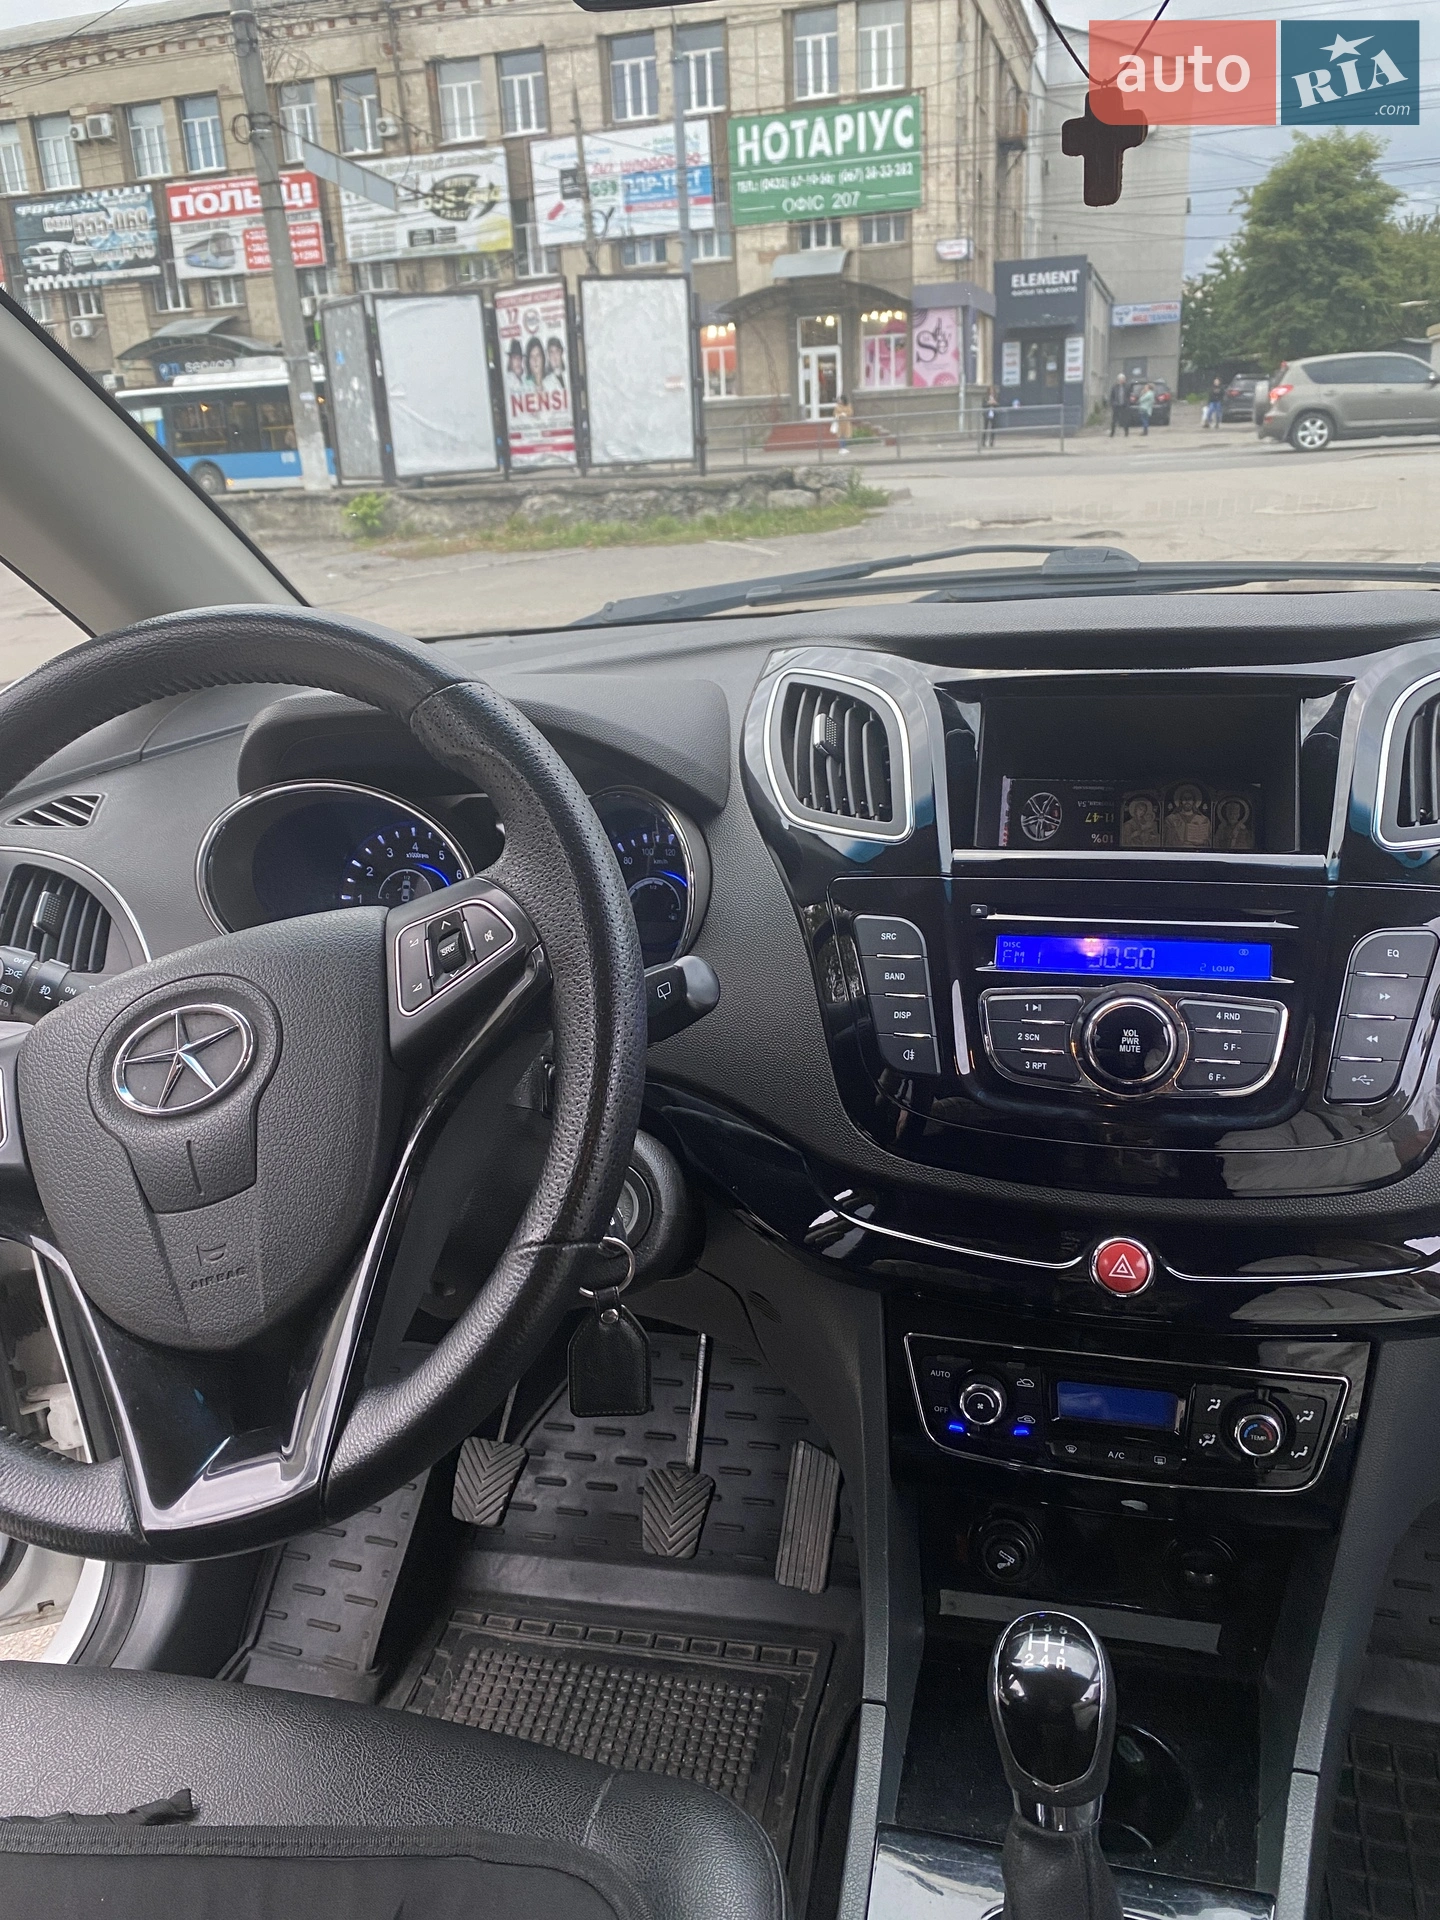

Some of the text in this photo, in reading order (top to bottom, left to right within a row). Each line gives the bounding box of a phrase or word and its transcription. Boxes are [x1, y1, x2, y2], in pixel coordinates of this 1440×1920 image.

[736, 104, 915, 168] НОТАРІУС
[781, 190, 861, 214] ОФІС 207
[1010, 268, 1081, 288] ELEMENT
[510, 388, 569, 418] NENSI
[412, 842, 419, 852] 4
[386, 848, 394, 858] 3
[438, 850, 445, 860] 5
[641, 848, 654, 857] 100
[665, 848, 676, 857] 120
[623, 857, 633, 865] 80
[366, 867, 374, 877] 2
[456, 870, 462, 880] 6
[880, 932, 897, 941] SRC
[439, 942, 456, 957] SRC
[1002, 941, 1021, 949] DISC
[1002, 949, 1025, 964] FM
[1387, 949, 1400, 958] EQ
[13, 957, 29, 965] OFF
[1211, 964, 1236, 973] LOUD
[884, 972, 906, 981] BAND
[64, 986, 77, 996] ON
[893, 1011, 912, 1020] DISP
[1216, 1012, 1241, 1021] 4 RND
[1017, 1032, 1040, 1041] 2 SCN
[1122, 1029, 1139, 1038] VOL
[1121, 1037, 1140, 1046] PWR
[1119, 1045, 1141, 1053] MUTE
[1223, 1042, 1229, 1051] 5
[1025, 1061, 1047, 1070] 3 RPT
[1208, 1072, 1213, 1081] 6
[930, 1369, 951, 1379] AUTO
[933, 1405, 949, 1413] OFF
[1250, 1434, 1267, 1442] TEMP
[1107, 1451, 1125, 1460] A/C
[1024, 1653, 1065, 1670] 2 4 R
